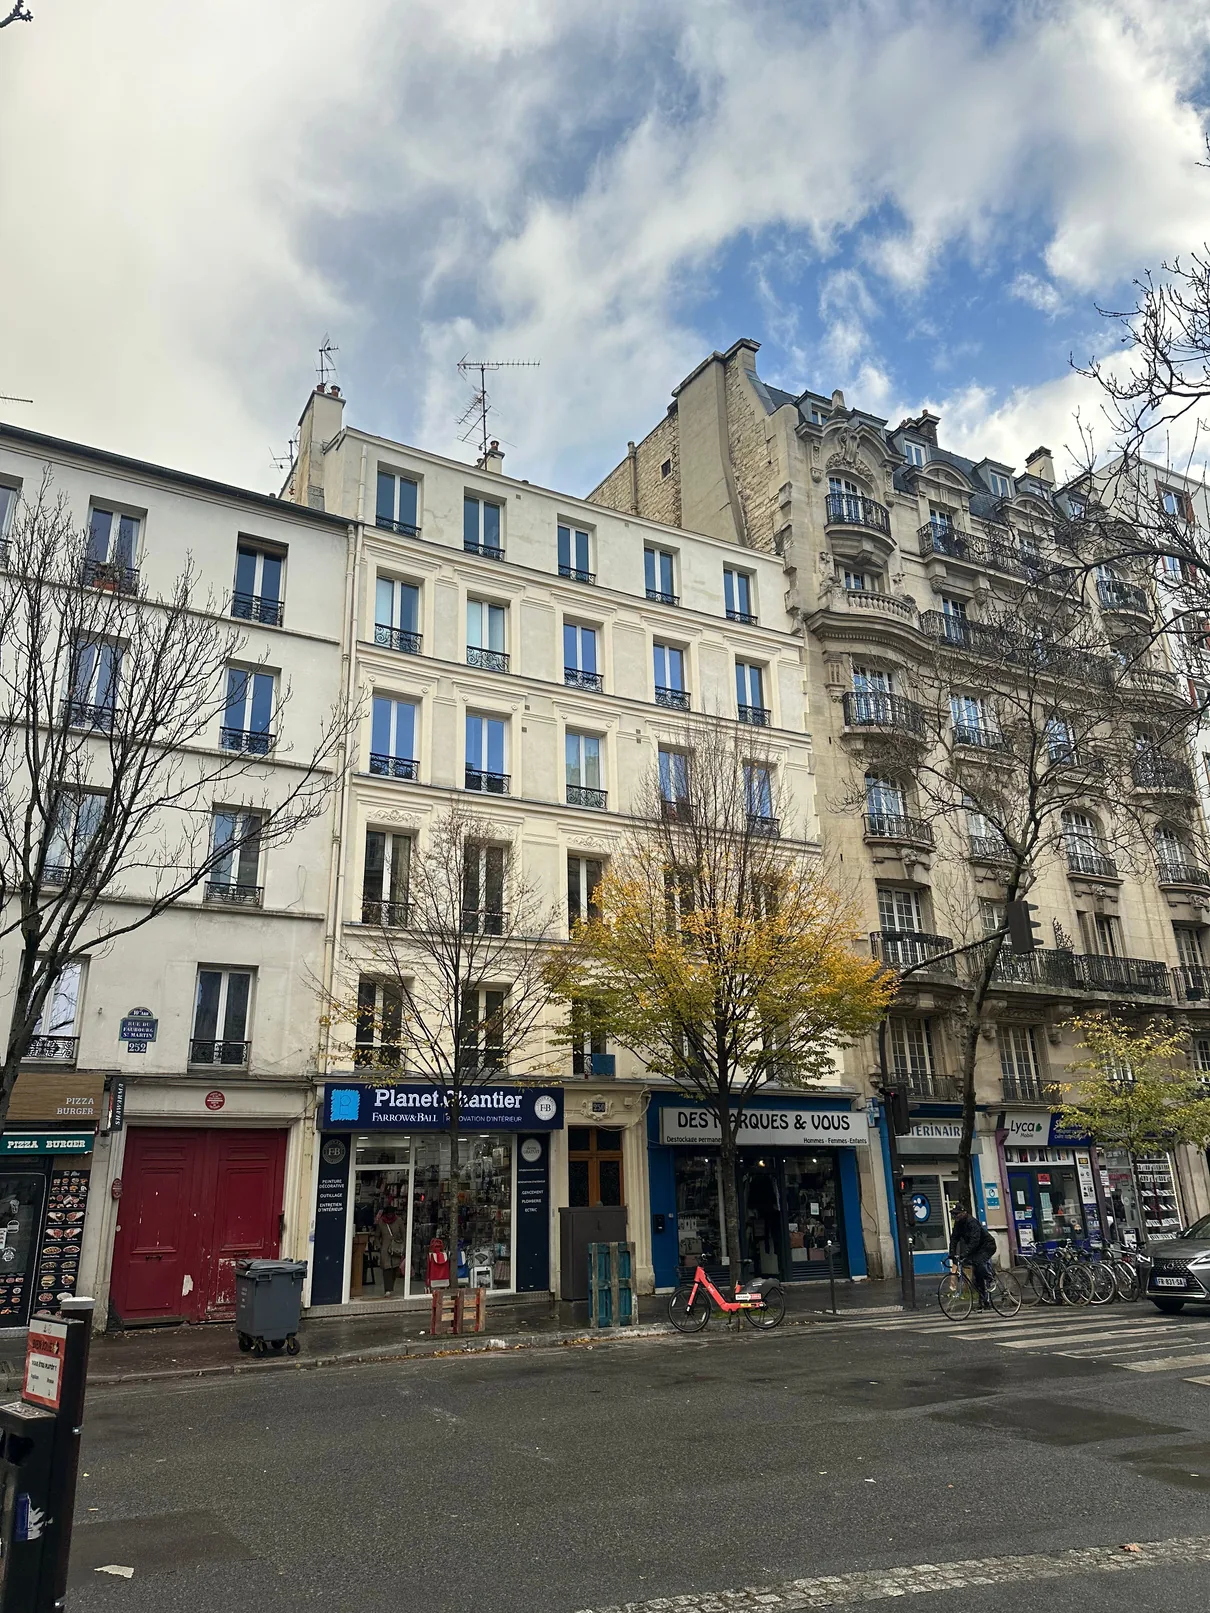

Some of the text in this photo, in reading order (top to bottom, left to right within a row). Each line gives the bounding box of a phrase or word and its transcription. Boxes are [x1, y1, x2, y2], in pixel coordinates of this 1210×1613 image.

[128, 1043, 146, 1052] 252
[65, 1097, 94, 1105] PIZZA
[374, 1089, 439, 1107] Planet
[115, 1083, 124, 1126] SHAWARMA
[57, 1107, 94, 1115] BURGER
[445, 1115, 485, 1123] ROVATION
[677, 1111, 709, 1129] DES
[793, 1114, 807, 1130] &
[811, 1114, 850, 1131] VOUS
[1010, 1120, 1035, 1134] Lyca
[7, 1140, 86, 1149] PIZZA BURGER
